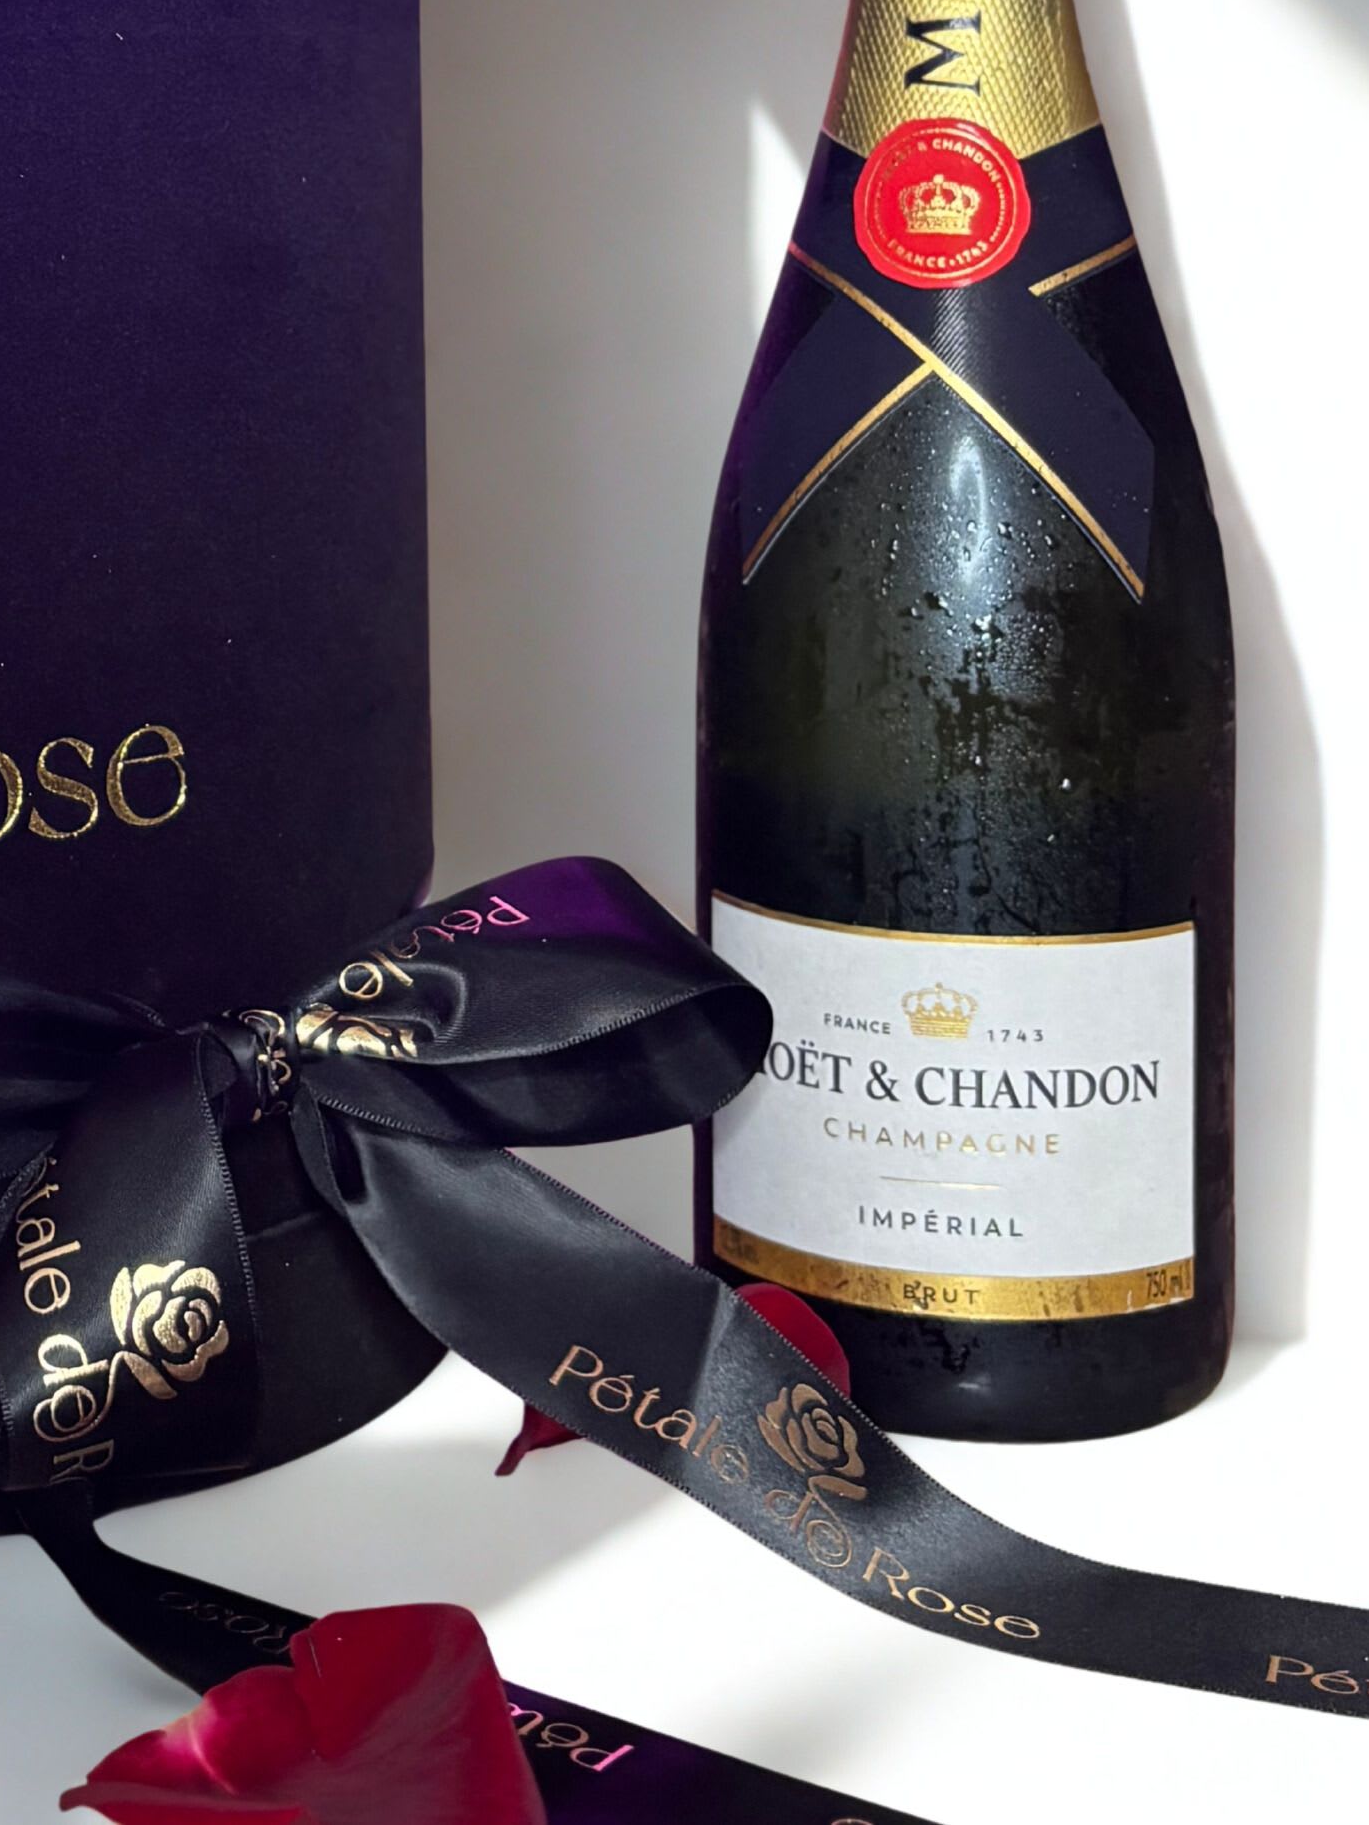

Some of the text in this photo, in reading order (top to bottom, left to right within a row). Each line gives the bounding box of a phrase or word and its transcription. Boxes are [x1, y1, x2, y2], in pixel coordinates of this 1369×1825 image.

[932, 137, 1002, 183] CHANDON
[822, 1012, 1045, 1043] FRANCE 1743
[758, 1038, 1161, 1111] OËT & CHANDON
[822, 1116, 1062, 1156] CHAMPAGNE
[15, 1156, 82, 1315] tale
[858, 1204, 1024, 1238] IMPÉRIAL
[902, 1282, 981, 1306] BRUT
[548, 1344, 750, 1485] Pétale
[861, 1545, 1041, 1640] Rose
